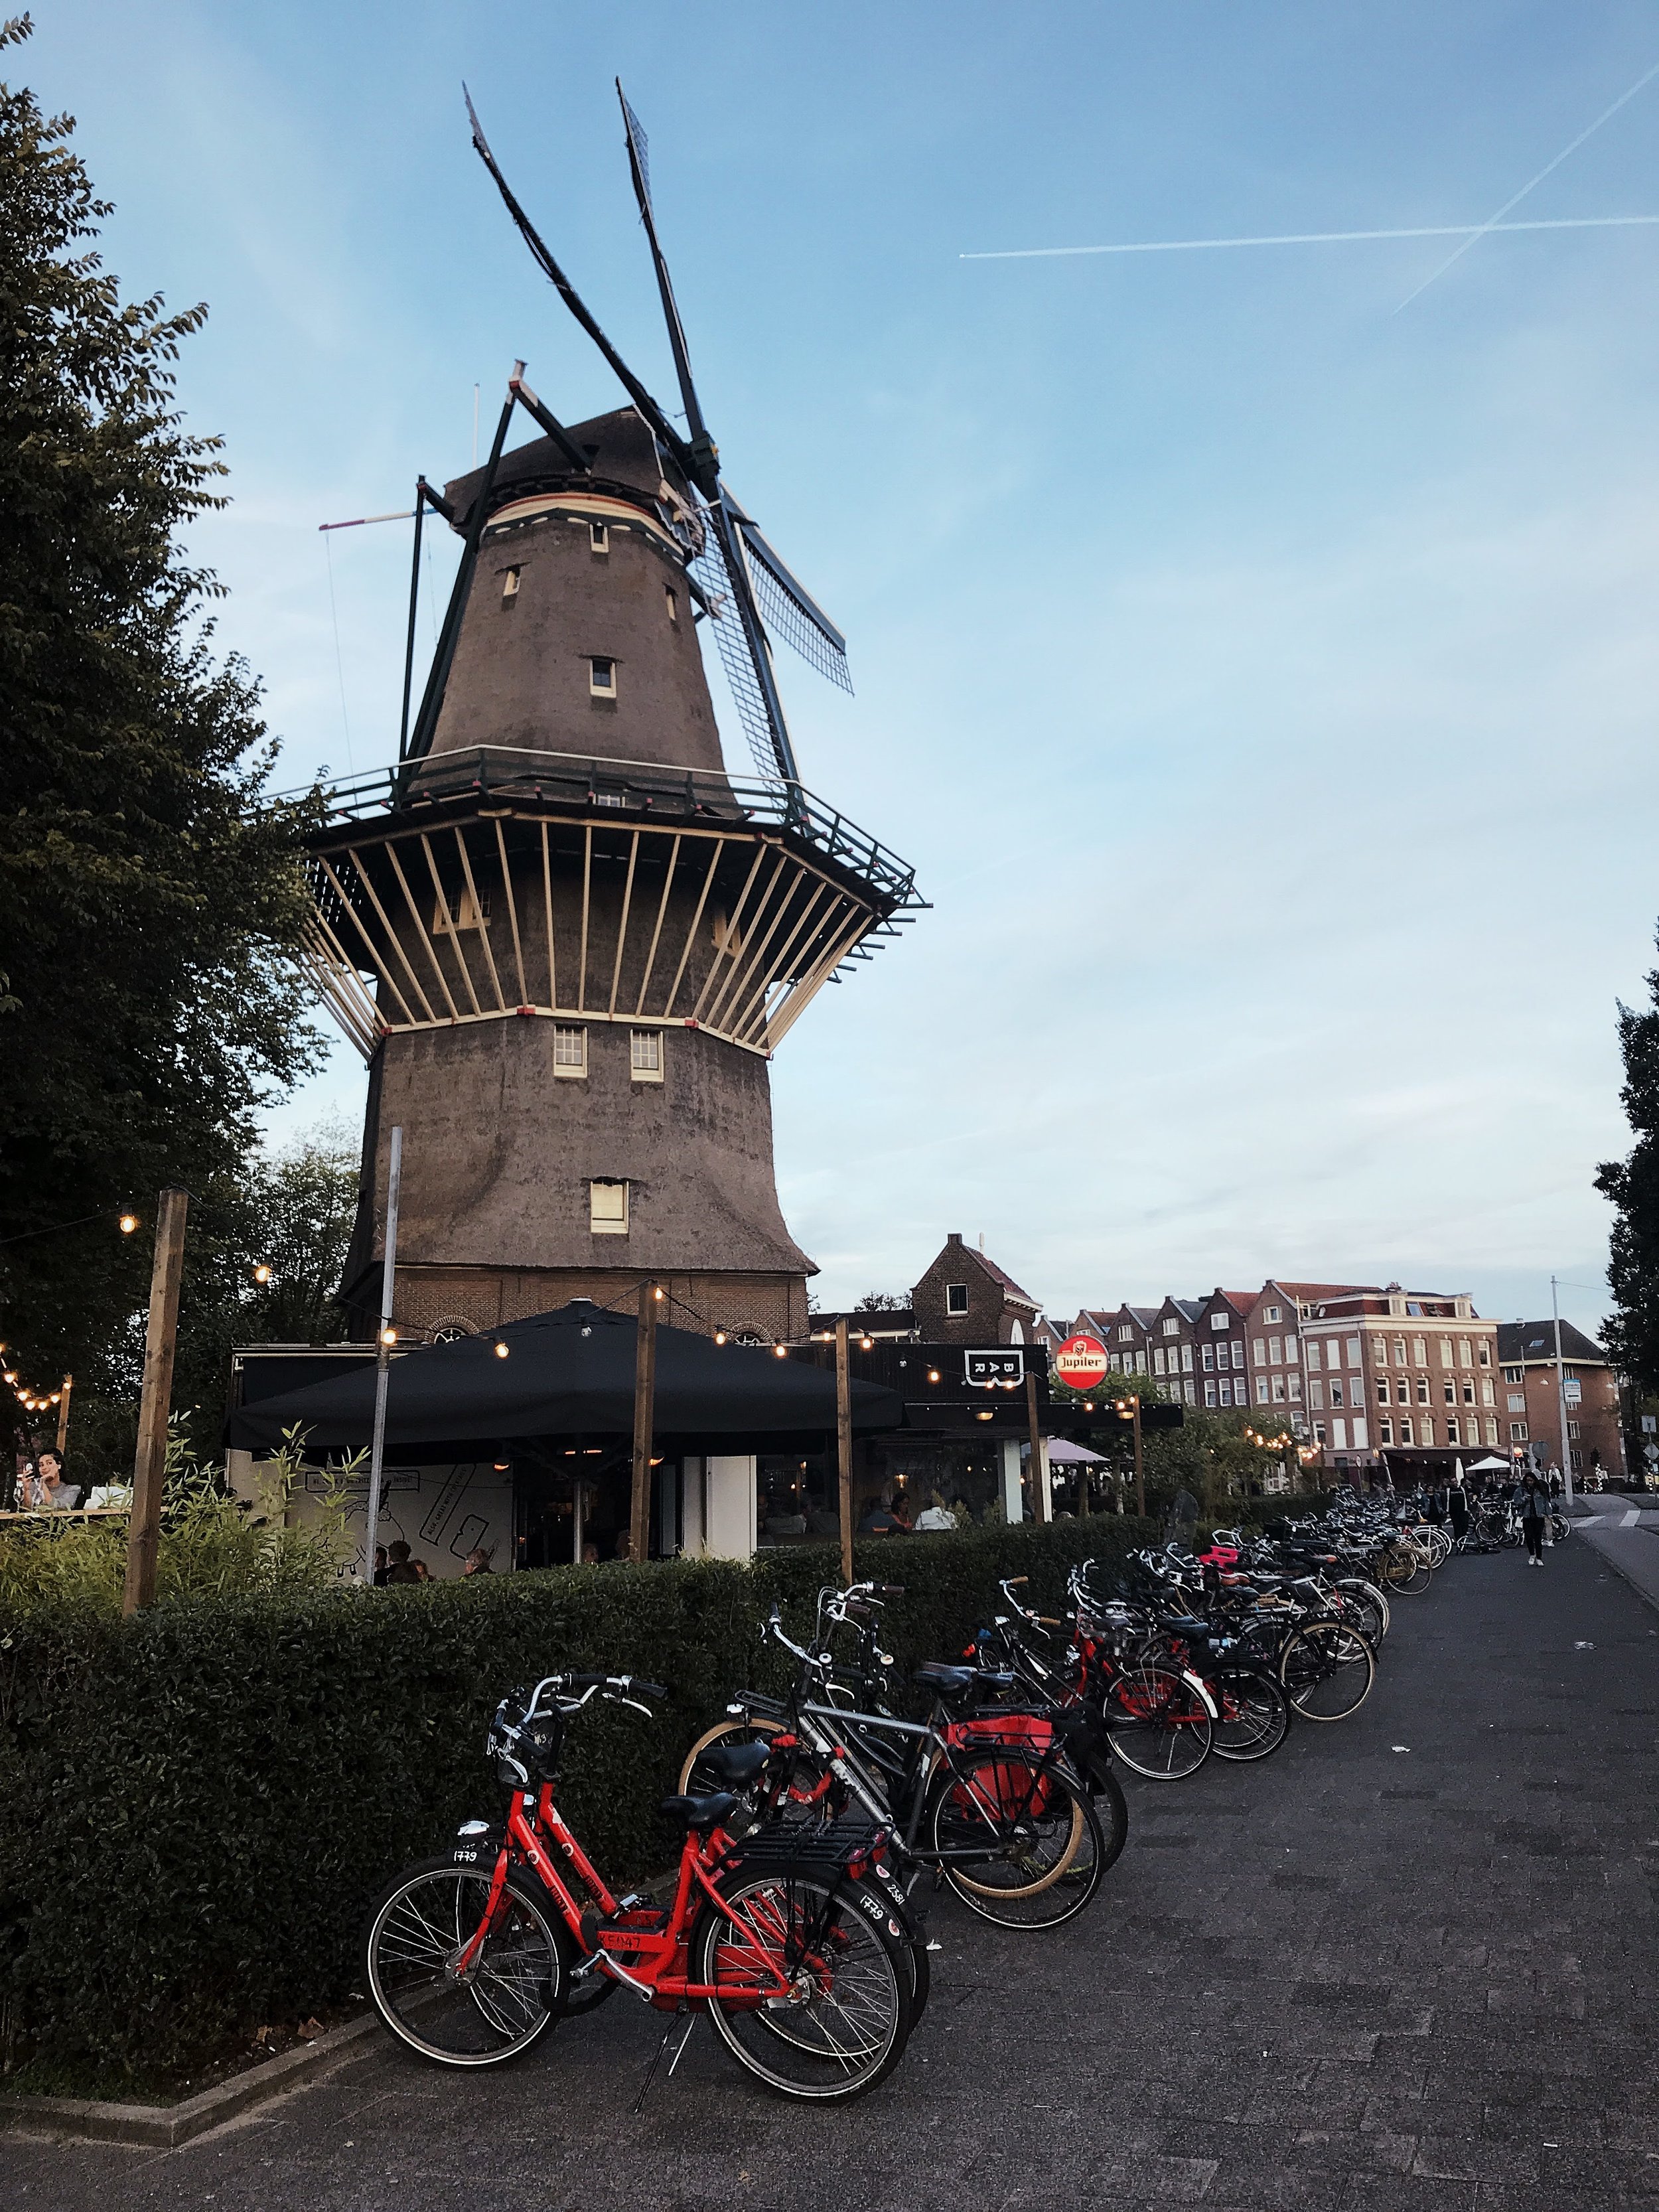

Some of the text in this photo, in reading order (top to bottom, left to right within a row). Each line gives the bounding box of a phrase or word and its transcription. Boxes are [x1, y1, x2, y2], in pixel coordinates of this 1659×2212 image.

[975, 1362, 1014, 1372] BAR
[1061, 1357, 1102, 1368] Jupiler
[454, 1850, 477, 1862] 1779
[887, 1884, 905, 1905] 2381
[860, 1894, 884, 1920] 1779
